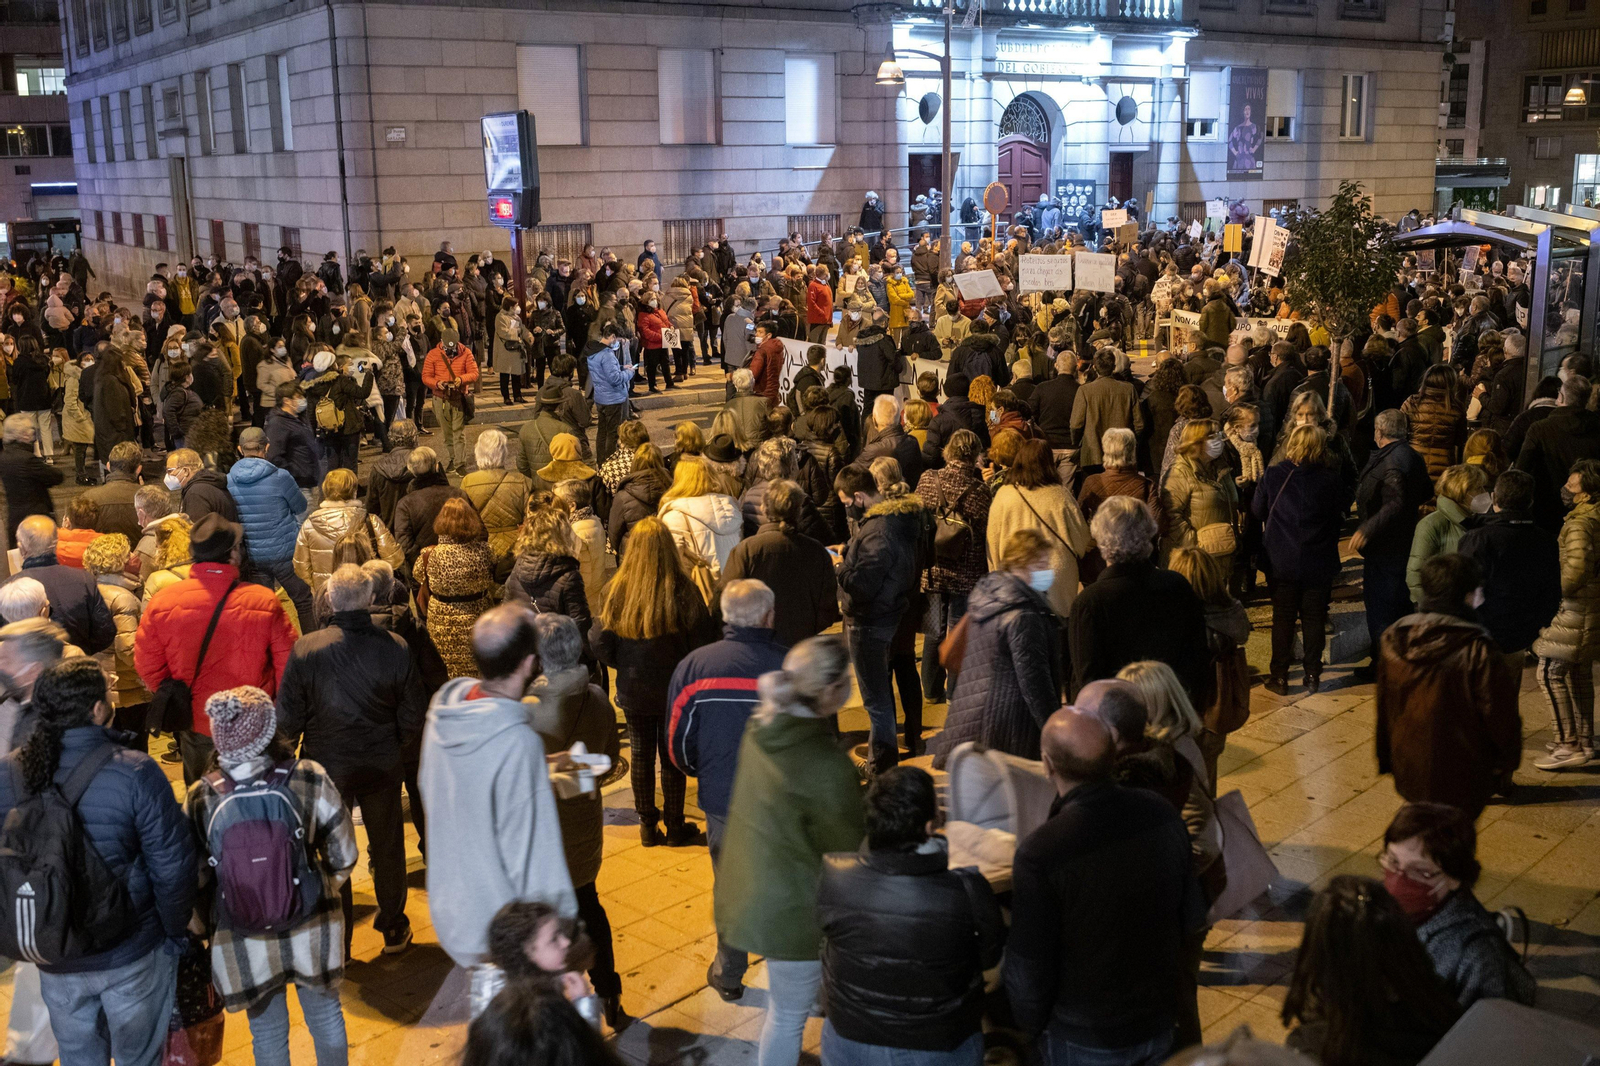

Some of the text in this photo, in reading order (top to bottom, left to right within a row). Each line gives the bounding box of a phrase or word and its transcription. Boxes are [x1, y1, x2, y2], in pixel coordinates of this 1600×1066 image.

[998, 62, 1018, 73] DEL
[1245, 86, 1264, 99] VIVAS
[1175, 315, 1191, 325] NON
